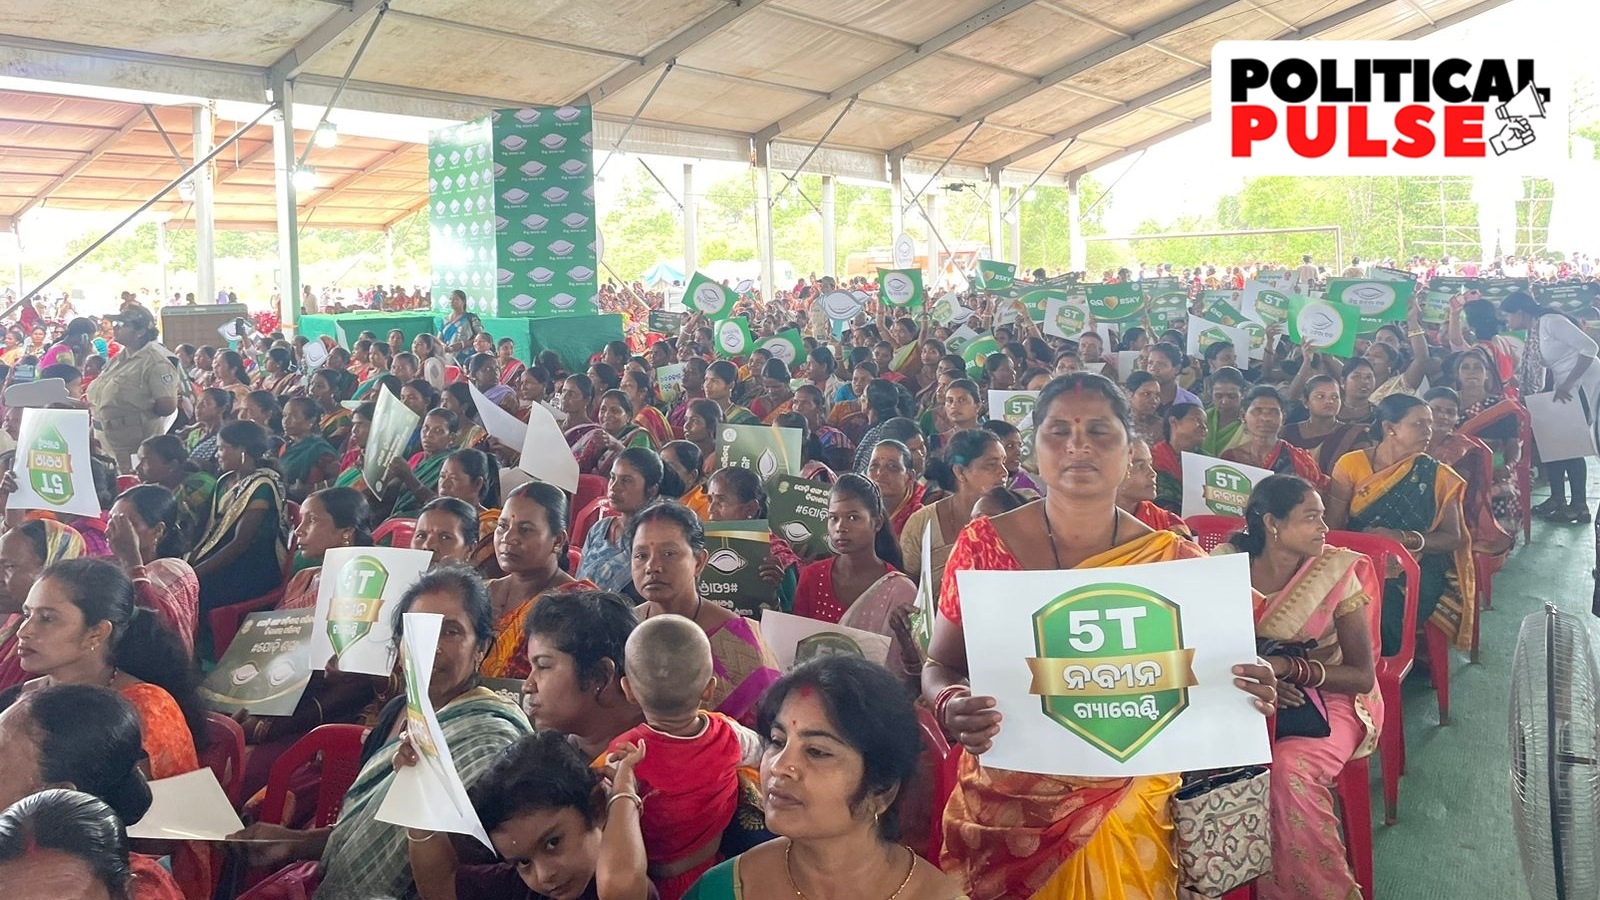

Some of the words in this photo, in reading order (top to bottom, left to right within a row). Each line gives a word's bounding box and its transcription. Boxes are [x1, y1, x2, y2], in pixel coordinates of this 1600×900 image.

[1264, 294, 1285, 306] 5T
[1063, 309, 1079, 319] 5T
[1012, 402, 1034, 414] 5T
[41, 473, 64, 494] 5T
[1215, 472, 1241, 490] 5T
[1068, 606, 1147, 653] 5T
[1062, 660, 1162, 690] ନବୀନ
